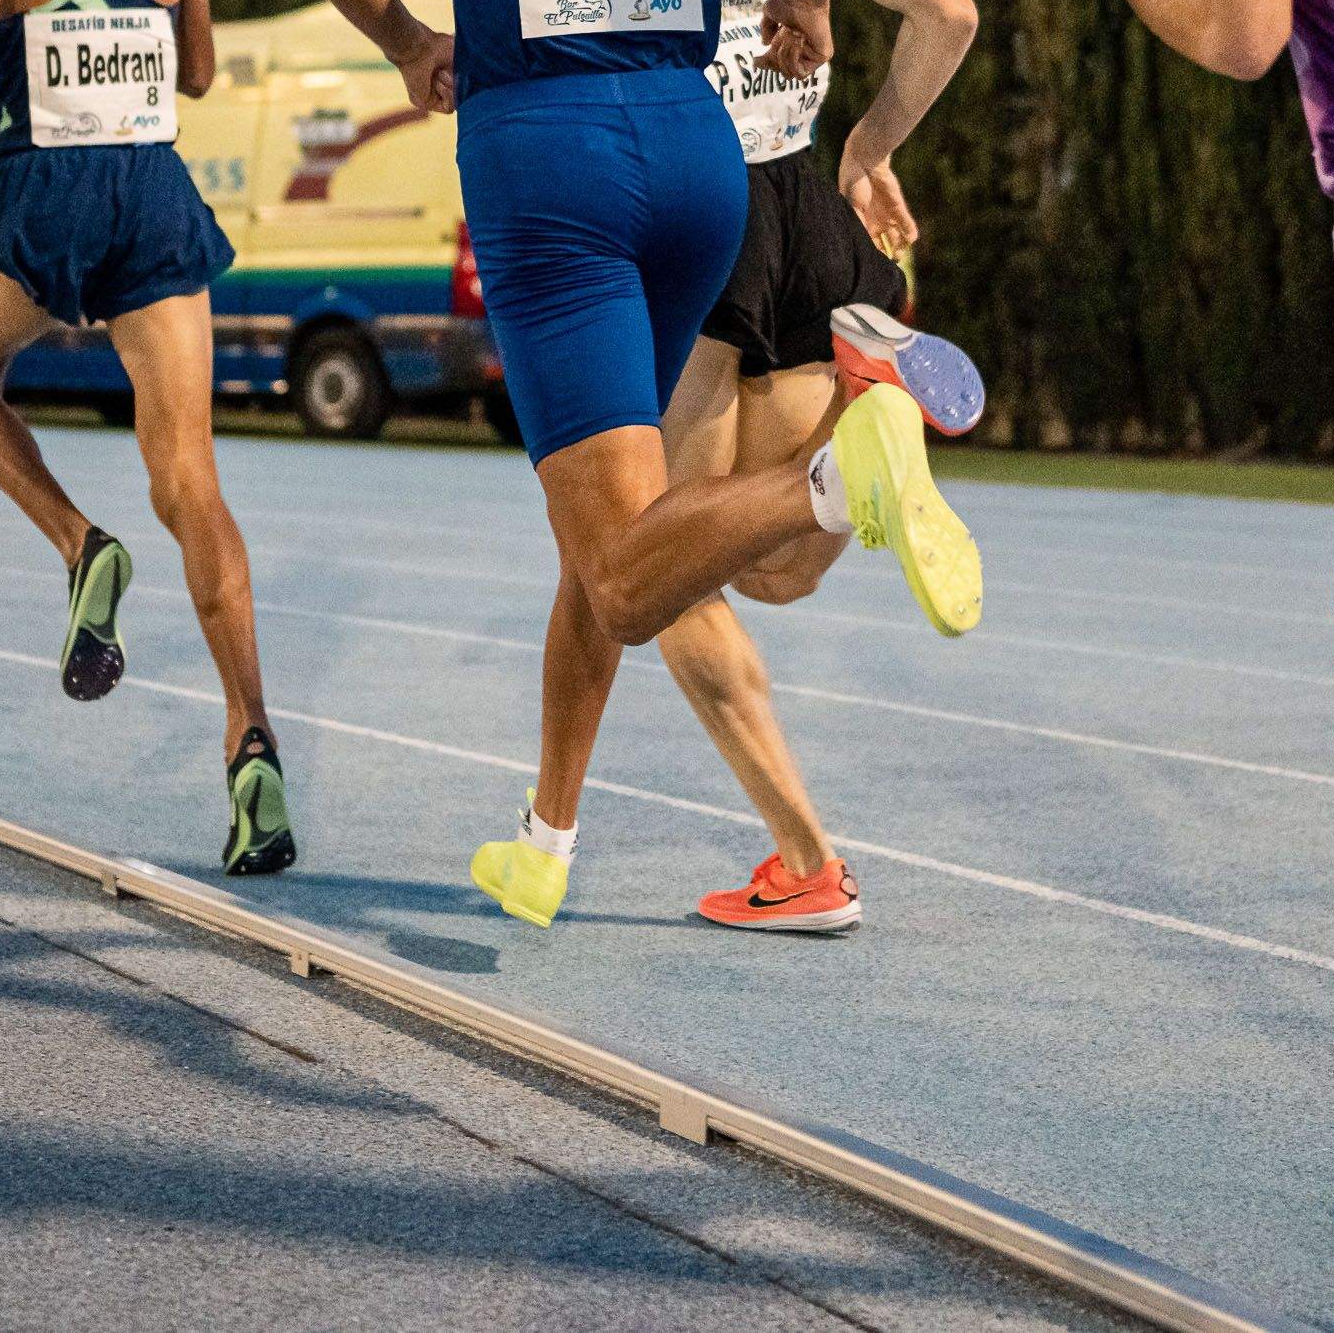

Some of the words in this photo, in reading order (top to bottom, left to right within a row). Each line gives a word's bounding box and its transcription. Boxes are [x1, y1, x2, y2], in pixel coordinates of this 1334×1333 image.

[110, 16, 151, 30] NERJA
[45, 44, 69, 87] D.
[77, 41, 165, 86] Bedrani
[710, 60, 734, 102] P.
[146, 85, 159, 107] 8
[797, 90, 818, 114] 10
